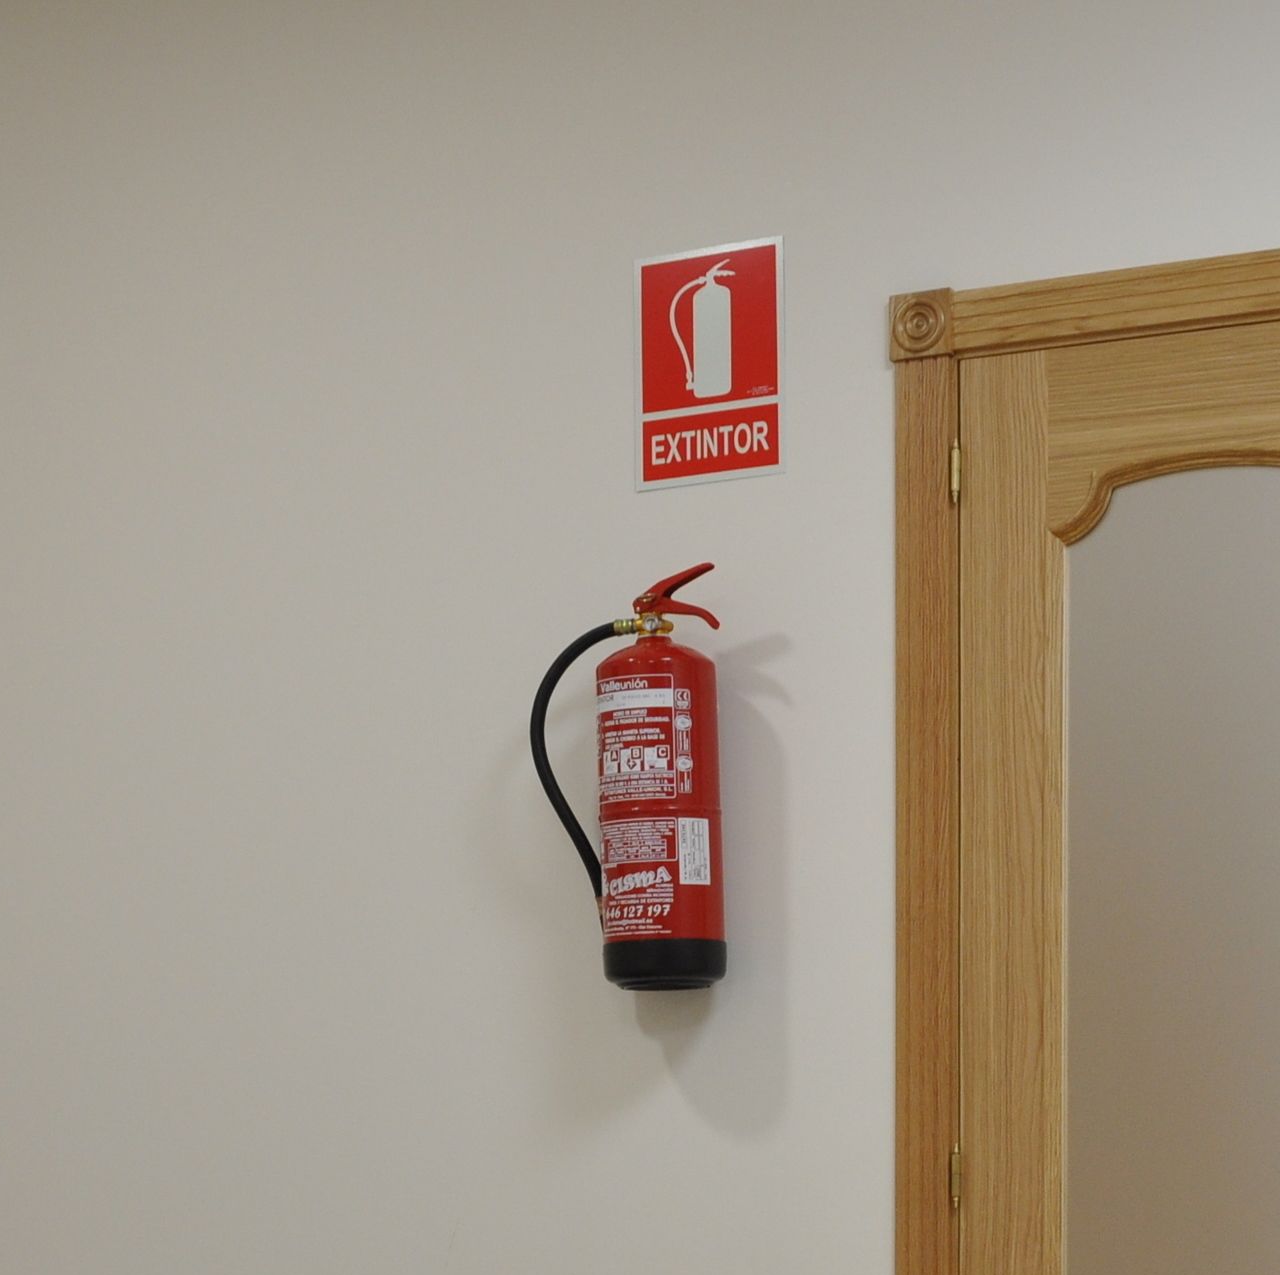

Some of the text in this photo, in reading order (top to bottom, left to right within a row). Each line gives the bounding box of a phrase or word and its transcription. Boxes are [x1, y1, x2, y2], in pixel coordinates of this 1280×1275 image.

[651, 421, 769, 466] EXTINTOR
[600, 678, 648, 693] Valleunión
[658, 747, 666, 757] C
[623, 904, 643, 919] 127
[648, 903, 671, 918] 197
